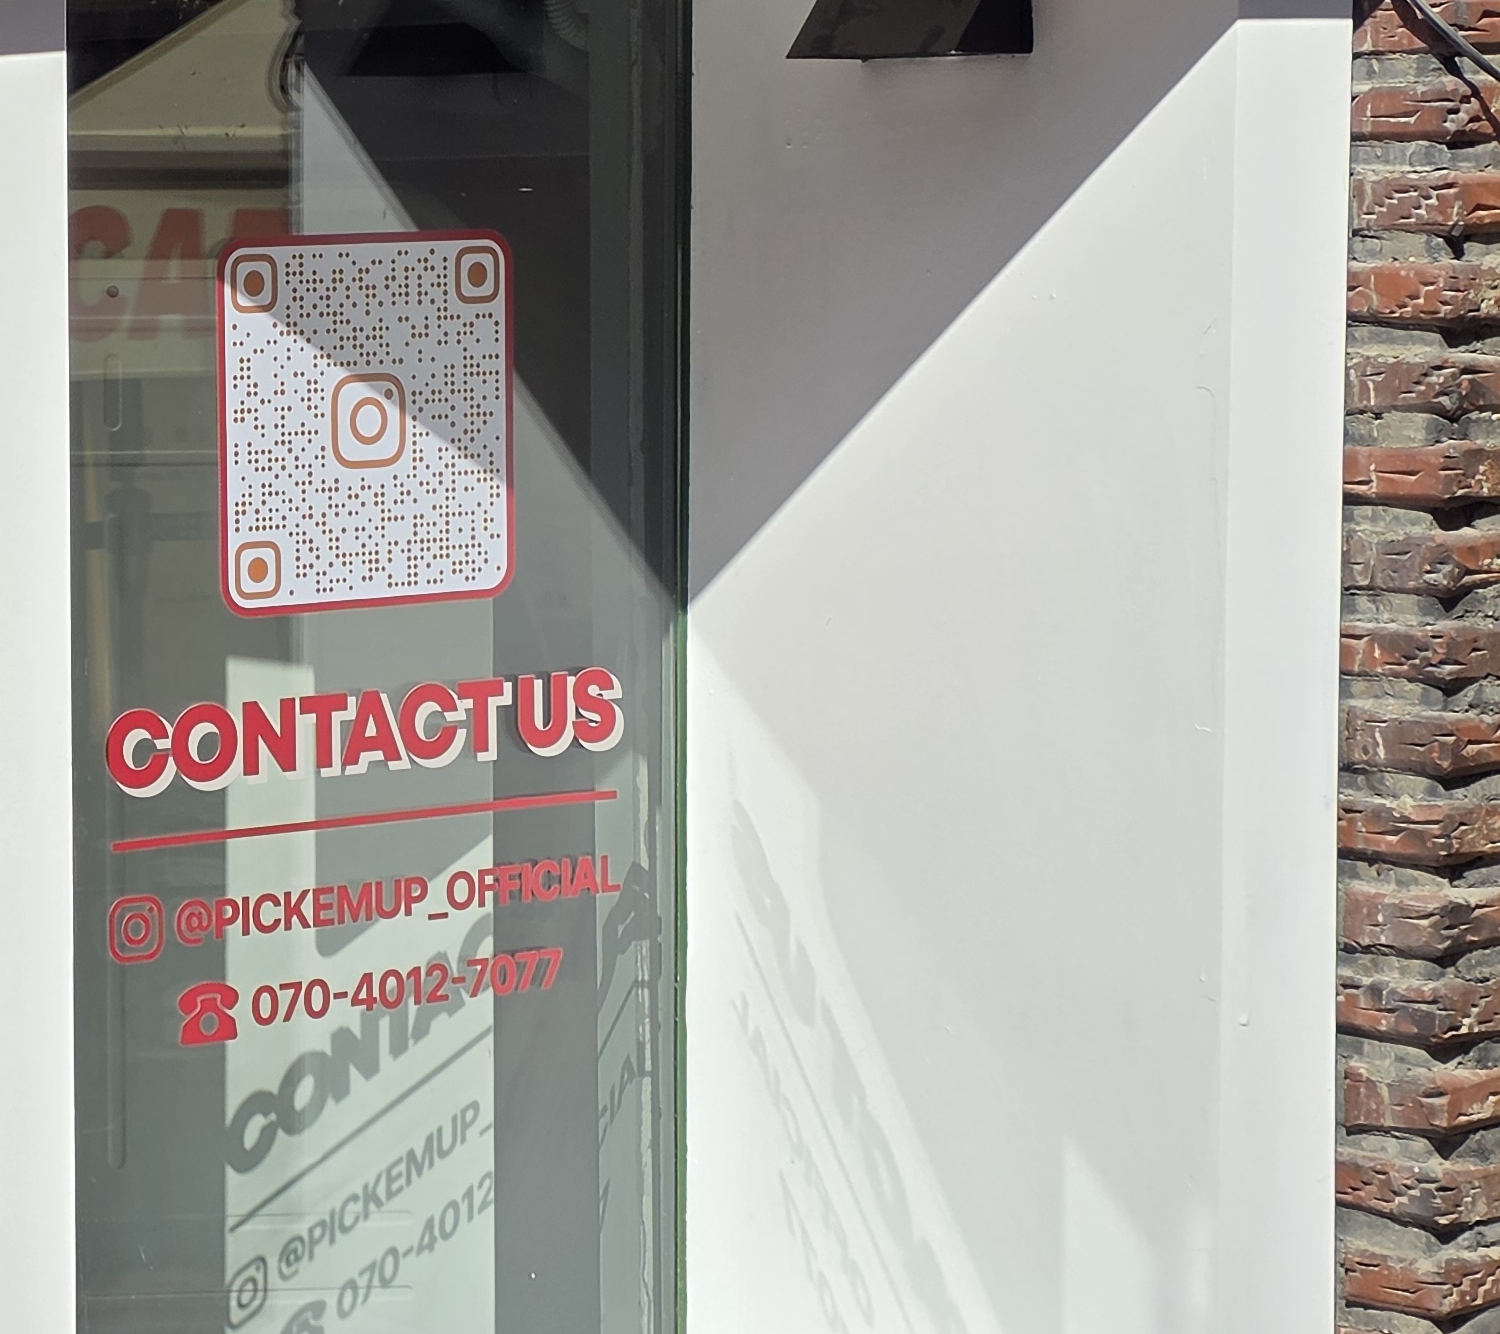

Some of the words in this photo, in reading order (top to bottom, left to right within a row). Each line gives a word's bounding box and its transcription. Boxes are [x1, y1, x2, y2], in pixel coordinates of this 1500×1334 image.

[106, 675, 510, 798] CONTACT
[517, 666, 624, 757] US
[176, 854, 621, 946] @PICKEMUP_OFFICIAL
[251, 948, 564, 1027] 070-4012-7077
